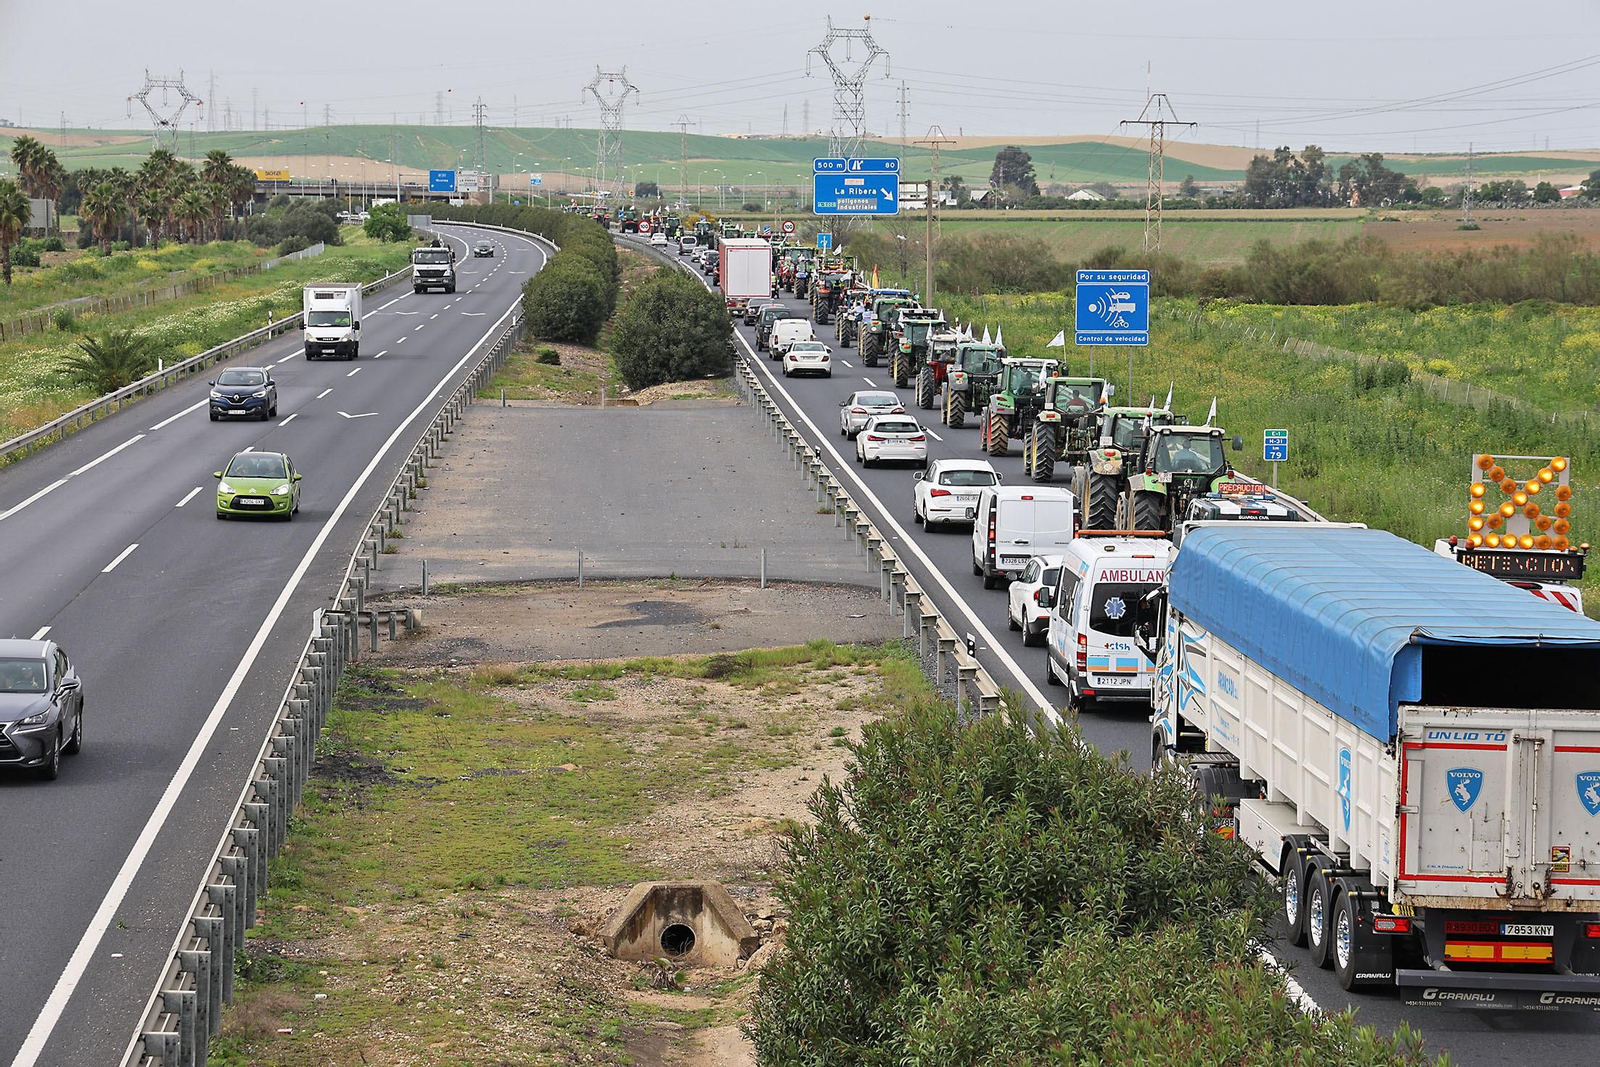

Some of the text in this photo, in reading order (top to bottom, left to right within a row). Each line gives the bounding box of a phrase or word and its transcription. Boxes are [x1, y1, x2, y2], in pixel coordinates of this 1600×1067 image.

[1109, 273, 1146, 281] seguridad
[1270, 451, 1282, 459] 79
[1219, 484, 1265, 492] PRECAUCION
[1100, 569, 1164, 582] AMBULAN
[1101, 677, 1118, 685] 2112
[1428, 731, 1452, 739] UN
[1453, 732, 1479, 740] LIO
[1507, 925, 1553, 936] 7853 KNY
[1438, 992, 1495, 1001] GRANALU
